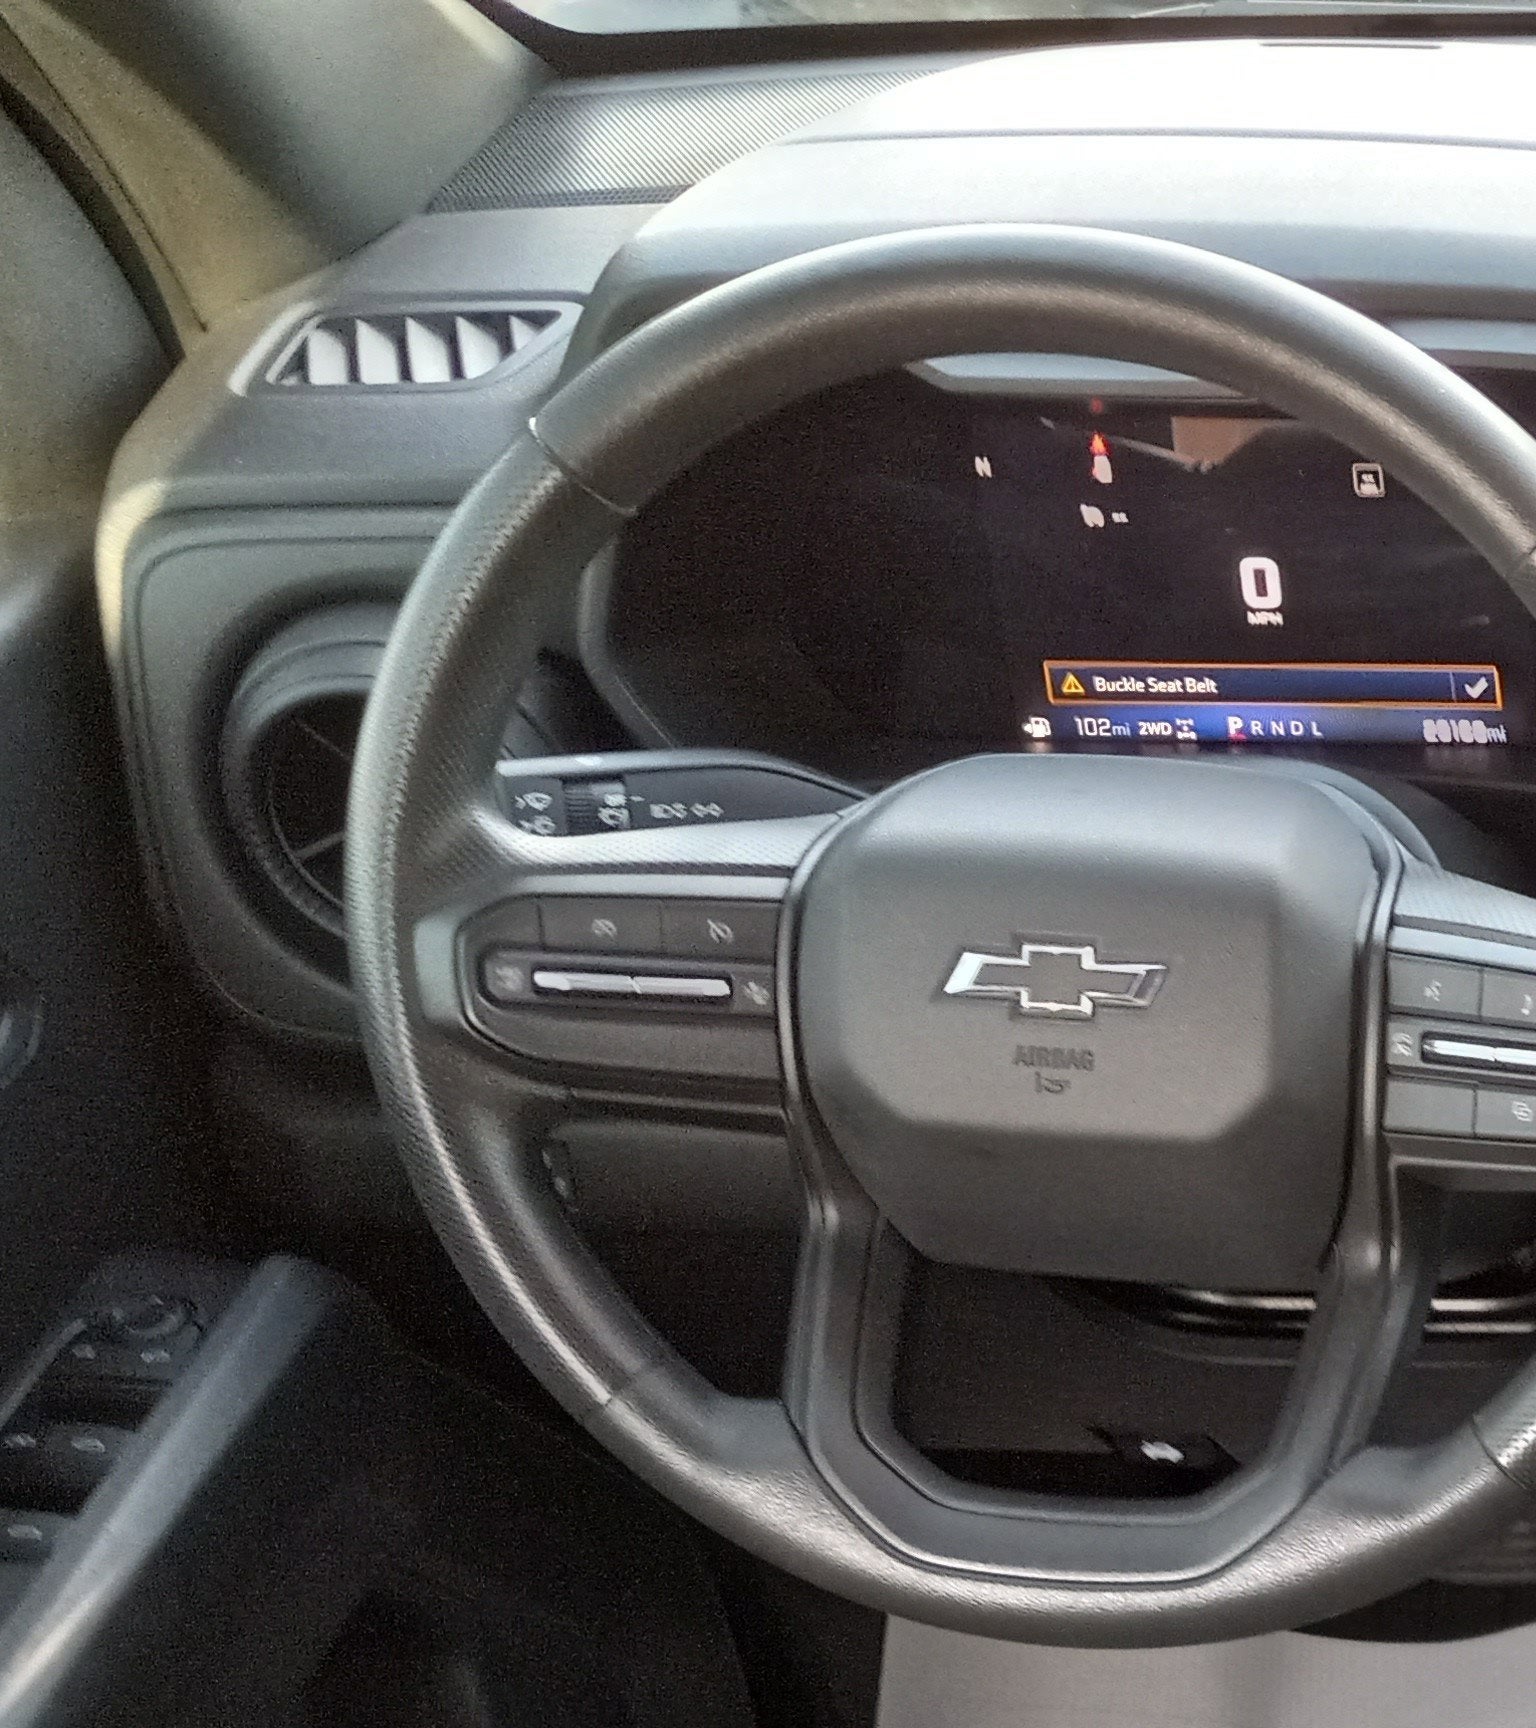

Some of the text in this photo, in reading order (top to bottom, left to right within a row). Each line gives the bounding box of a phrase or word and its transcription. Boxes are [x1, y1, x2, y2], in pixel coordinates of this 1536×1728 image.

[1238, 556, 1282, 609] 0
[1247, 611, 1283, 626] MPH
[1093, 676, 1217, 694] Buckle Seat Belt
[1138, 721, 1172, 735] 2WD
